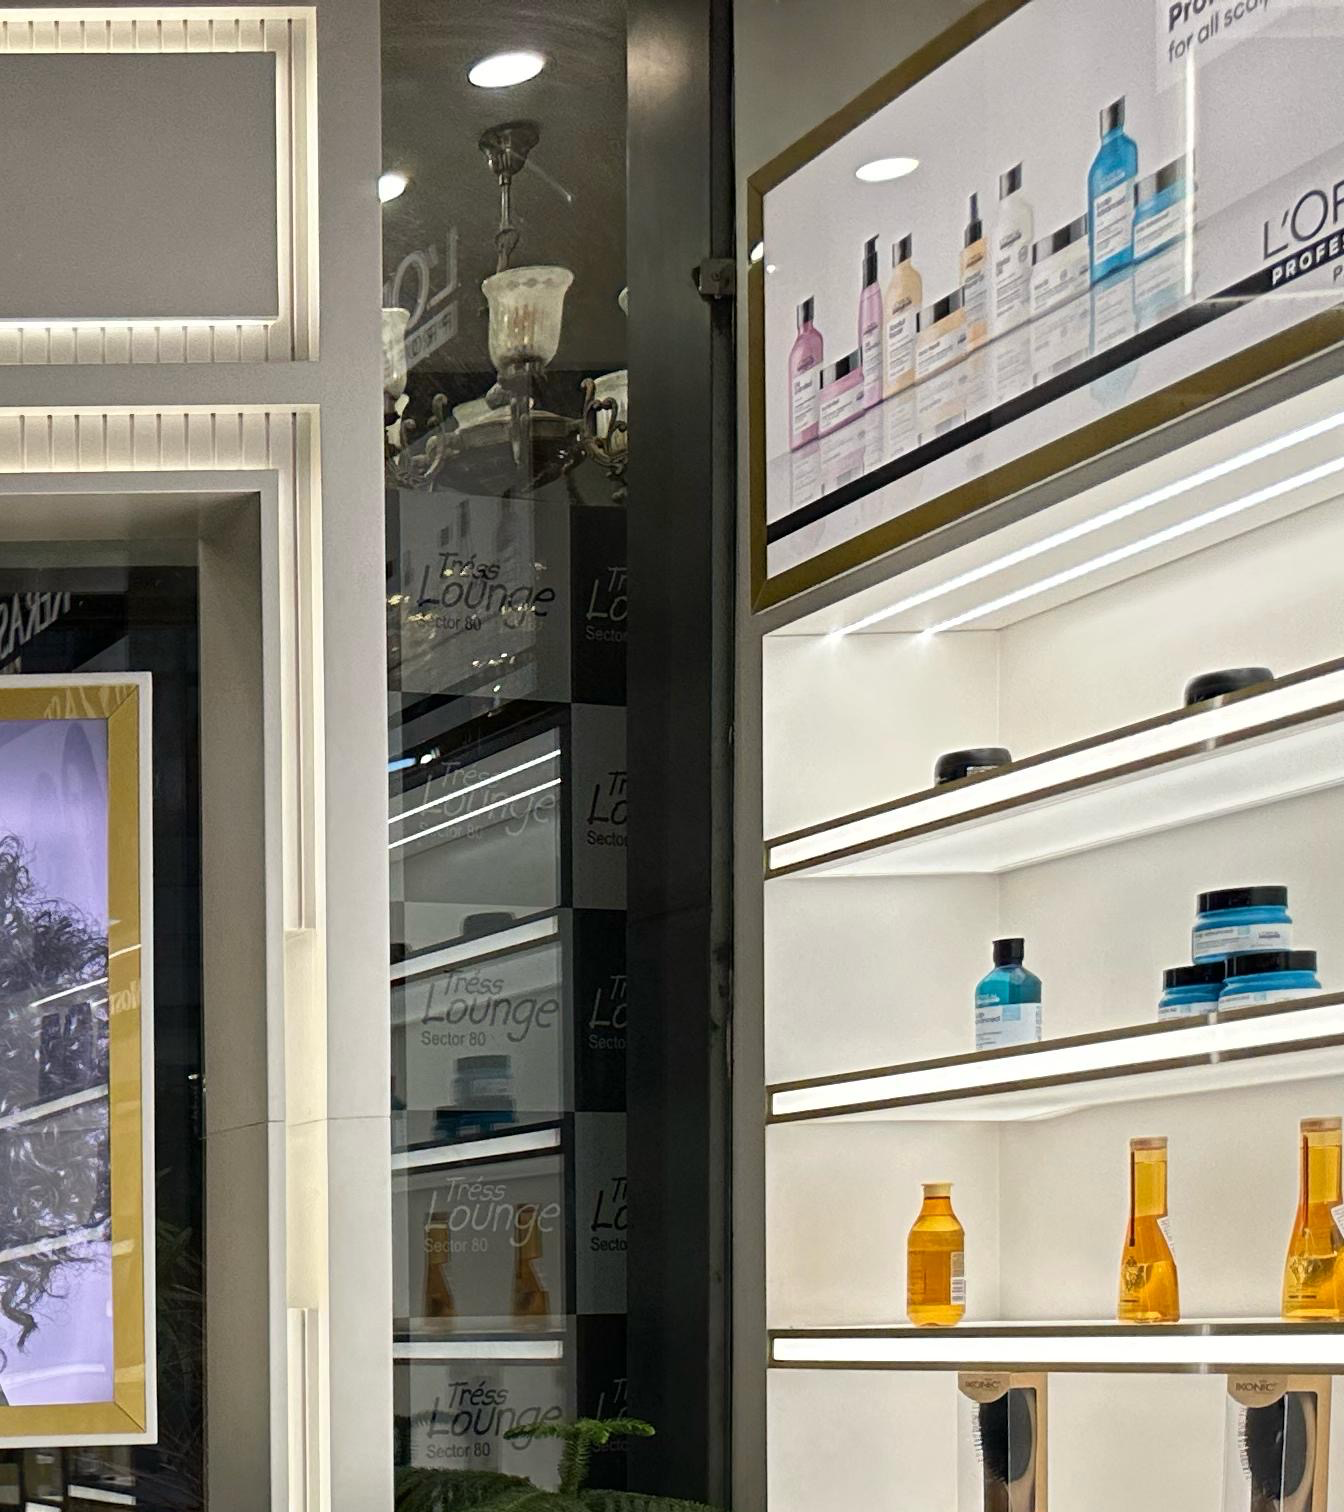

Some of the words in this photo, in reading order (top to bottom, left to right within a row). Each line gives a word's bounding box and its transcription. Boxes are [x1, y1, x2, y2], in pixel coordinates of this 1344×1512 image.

[1169, 33, 1194, 63] for
[1198, 11, 1219, 44] all
[1272, 234, 1344, 287] PROFE
[418, 564, 556, 629] Lounge
[443, 969, 505, 996] Tréss
[421, 983, 559, 1042] Lounge
[421, 1030, 464, 1046] Sector
[468, 1031, 486, 1046] 80
[445, 1176, 507, 1203] Tréss
[424, 1190, 561, 1247] Lounge
[424, 1238, 468, 1252] Sector
[472, 1237, 488, 1252] 80
[448, 1381, 509, 1409] Tréss
[426, 1444, 471, 1460] Sector
[474, 1442, 491, 1457] 80
